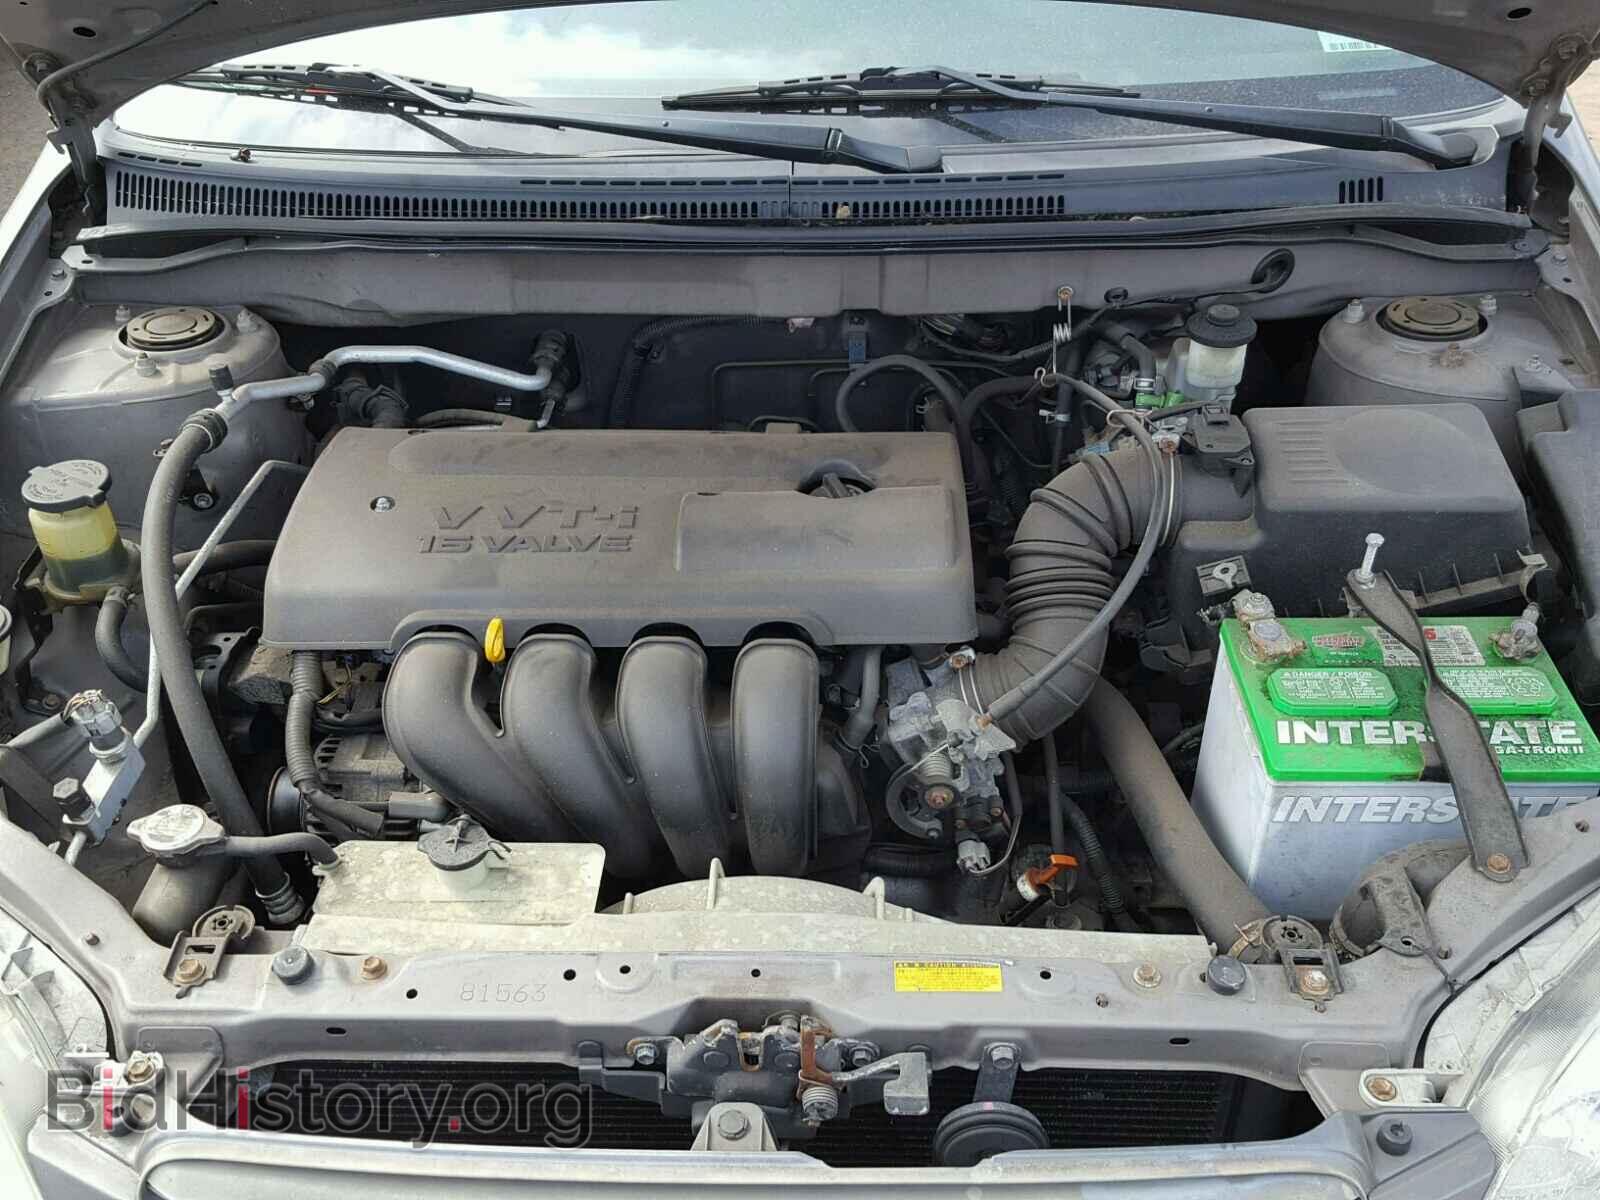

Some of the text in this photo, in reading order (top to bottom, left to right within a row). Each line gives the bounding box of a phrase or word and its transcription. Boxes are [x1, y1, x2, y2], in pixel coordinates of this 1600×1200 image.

[480, 534, 633, 553] VALVE
[1276, 720, 1584, 745] INTERATE
[1495, 745, 1569, 754] GA-TRON
[460, 983, 547, 1003] 81563
